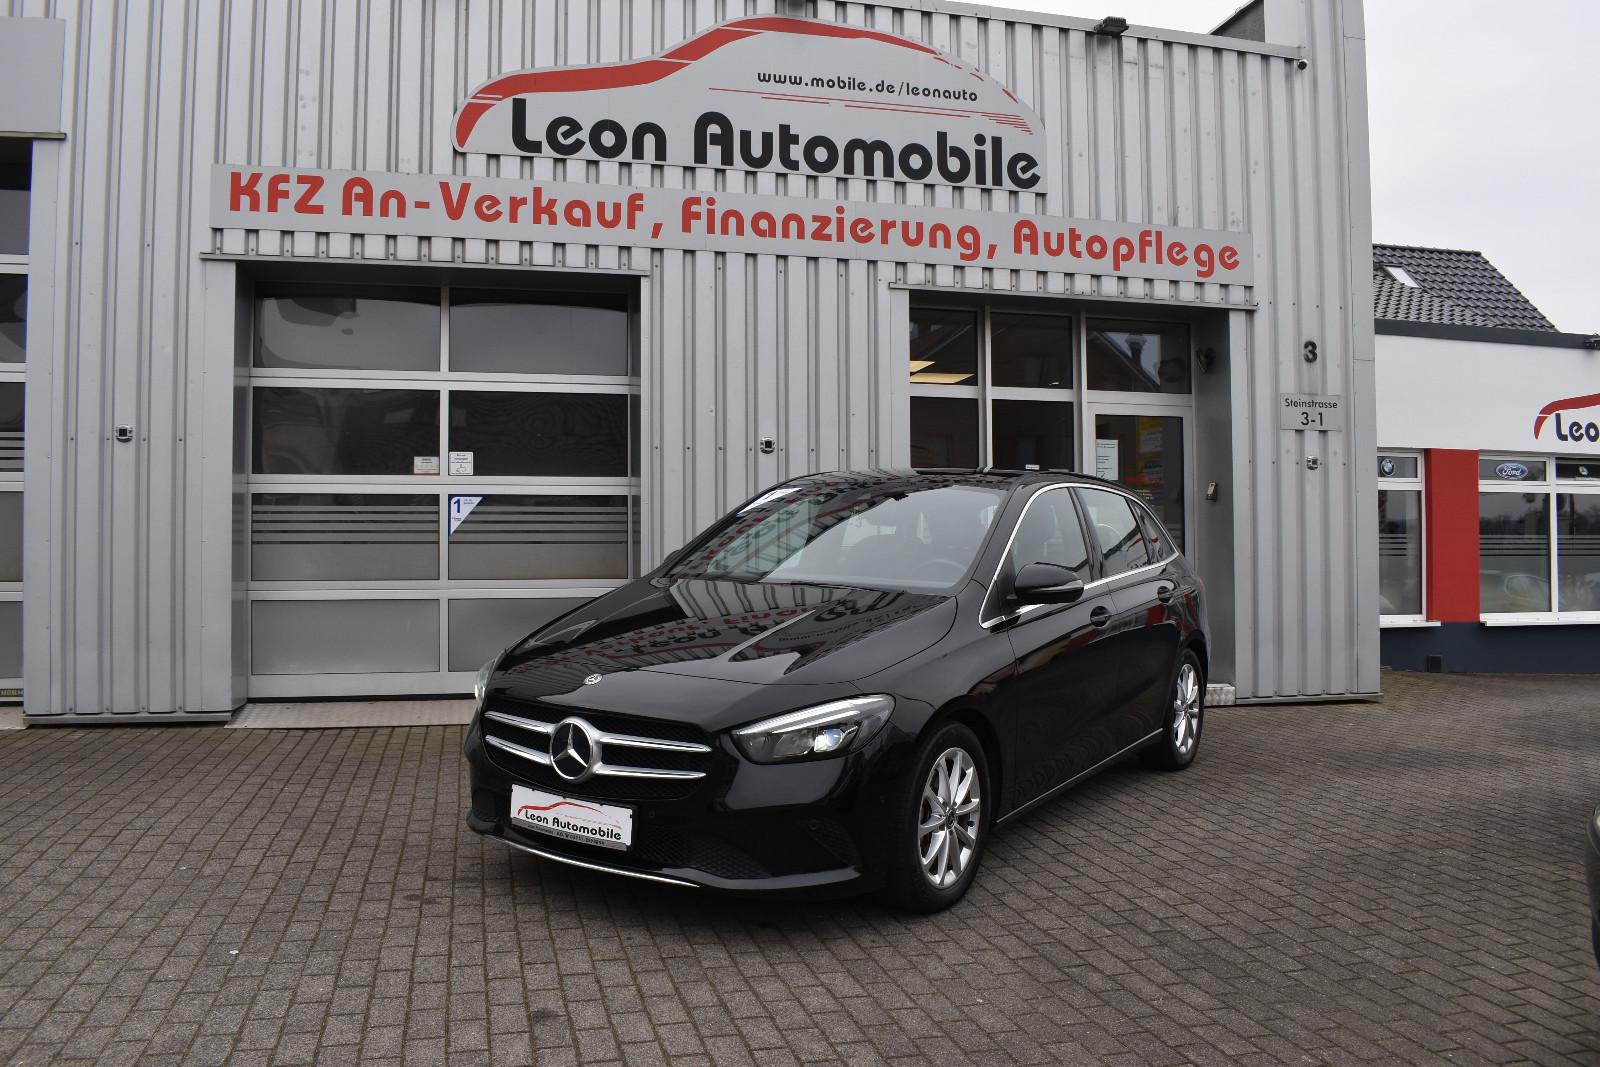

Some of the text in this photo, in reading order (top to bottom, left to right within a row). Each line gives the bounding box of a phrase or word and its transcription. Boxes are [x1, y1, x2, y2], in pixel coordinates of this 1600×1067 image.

[757, 72, 978, 102] www.mobile.de/leonauto
[512, 98, 1041, 190] Leon Automobile
[343, 177, 663, 239] An-Verkauf,
[682, 196, 997, 261] Finanzierung,
[1014, 219, 1240, 278] Autopflege
[1303, 340, 1318, 364] 3
[1284, 397, 1338, 409] Steinstrasse
[1300, 411, 1324, 427] 3-1
[454, 498, 461, 513] 1
[525, 809, 549, 824] Leon
[552, 816, 622, 840] Automobile
